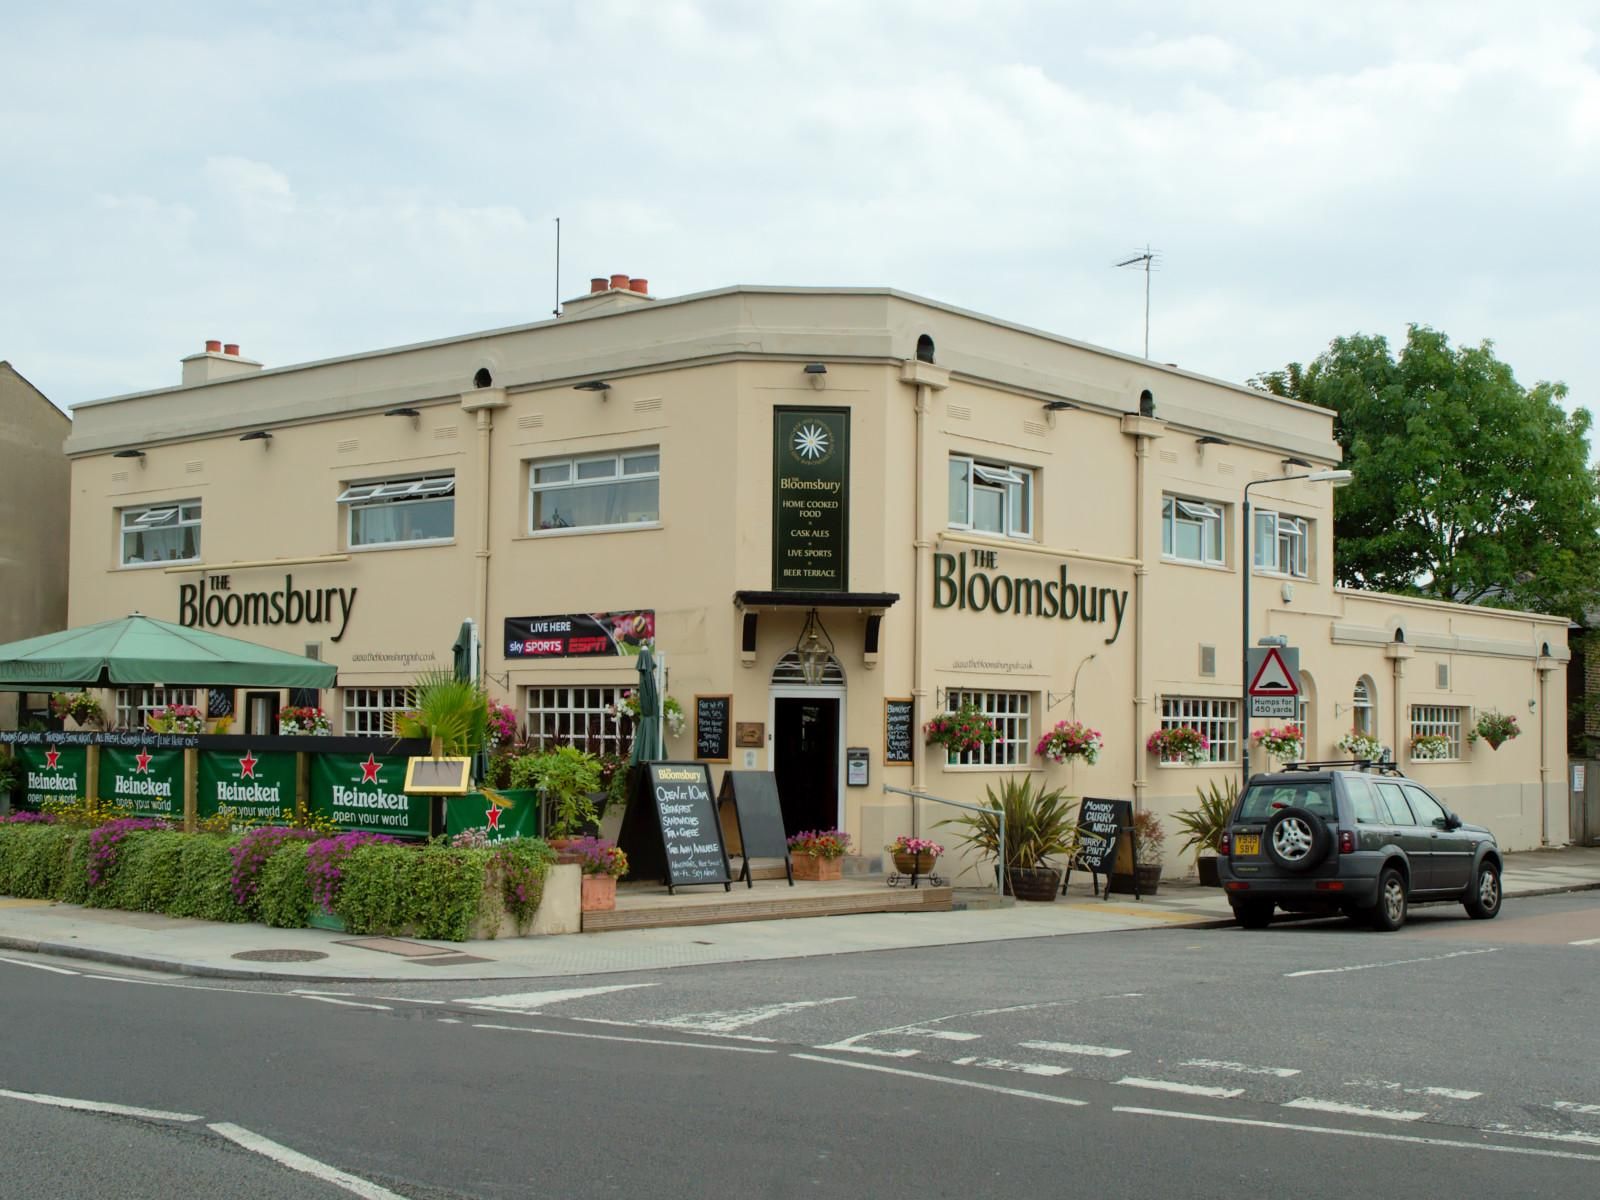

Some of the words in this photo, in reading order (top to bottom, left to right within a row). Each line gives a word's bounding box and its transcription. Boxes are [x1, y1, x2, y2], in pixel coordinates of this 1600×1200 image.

[780, 478, 840, 494] Bloomsbury
[782, 500, 806, 508] HOME
[799, 510, 821, 518] FOOD
[971, 549, 998, 569] THE
[803, 569, 836, 577] TERRACE
[209, 575, 231, 590] THE
[933, 552, 1128, 645] Bloomsbury
[179, 574, 357, 642] Bloomsbury
[530, 622, 548, 633] LIVE
[549, 621, 571, 632] HERE
[509, 641, 523, 653] sky
[525, 640, 561, 652] SPORTS
[568, 637, 607, 652] ESPN
[1273, 706, 1292, 714] yards
[28, 772, 77, 791] Heineken
[658, 769, 701, 783] Bloomsbury
[114, 775, 172, 796] Heineken
[217, 781, 280, 802] Heineken
[27, 794, 43, 803] open
[59, 794, 77, 804] world
[332, 785, 409, 810] Heineken
[656, 786, 680, 802] OPEN
[135, 800, 151, 810] your
[152, 800, 171, 811] world
[218, 804, 237, 816] open
[238, 806, 256, 818] your
[257, 806, 280, 818] world
[1085, 801, 1113, 812] MONDAY
[333, 810, 357, 824] open
[358, 812, 379, 826] your
[381, 812, 409, 826] world
[1086, 812, 1114, 823] CURRY
[1092, 823, 1117, 833] NIGHT
[1086, 847, 1105, 855] PINT
